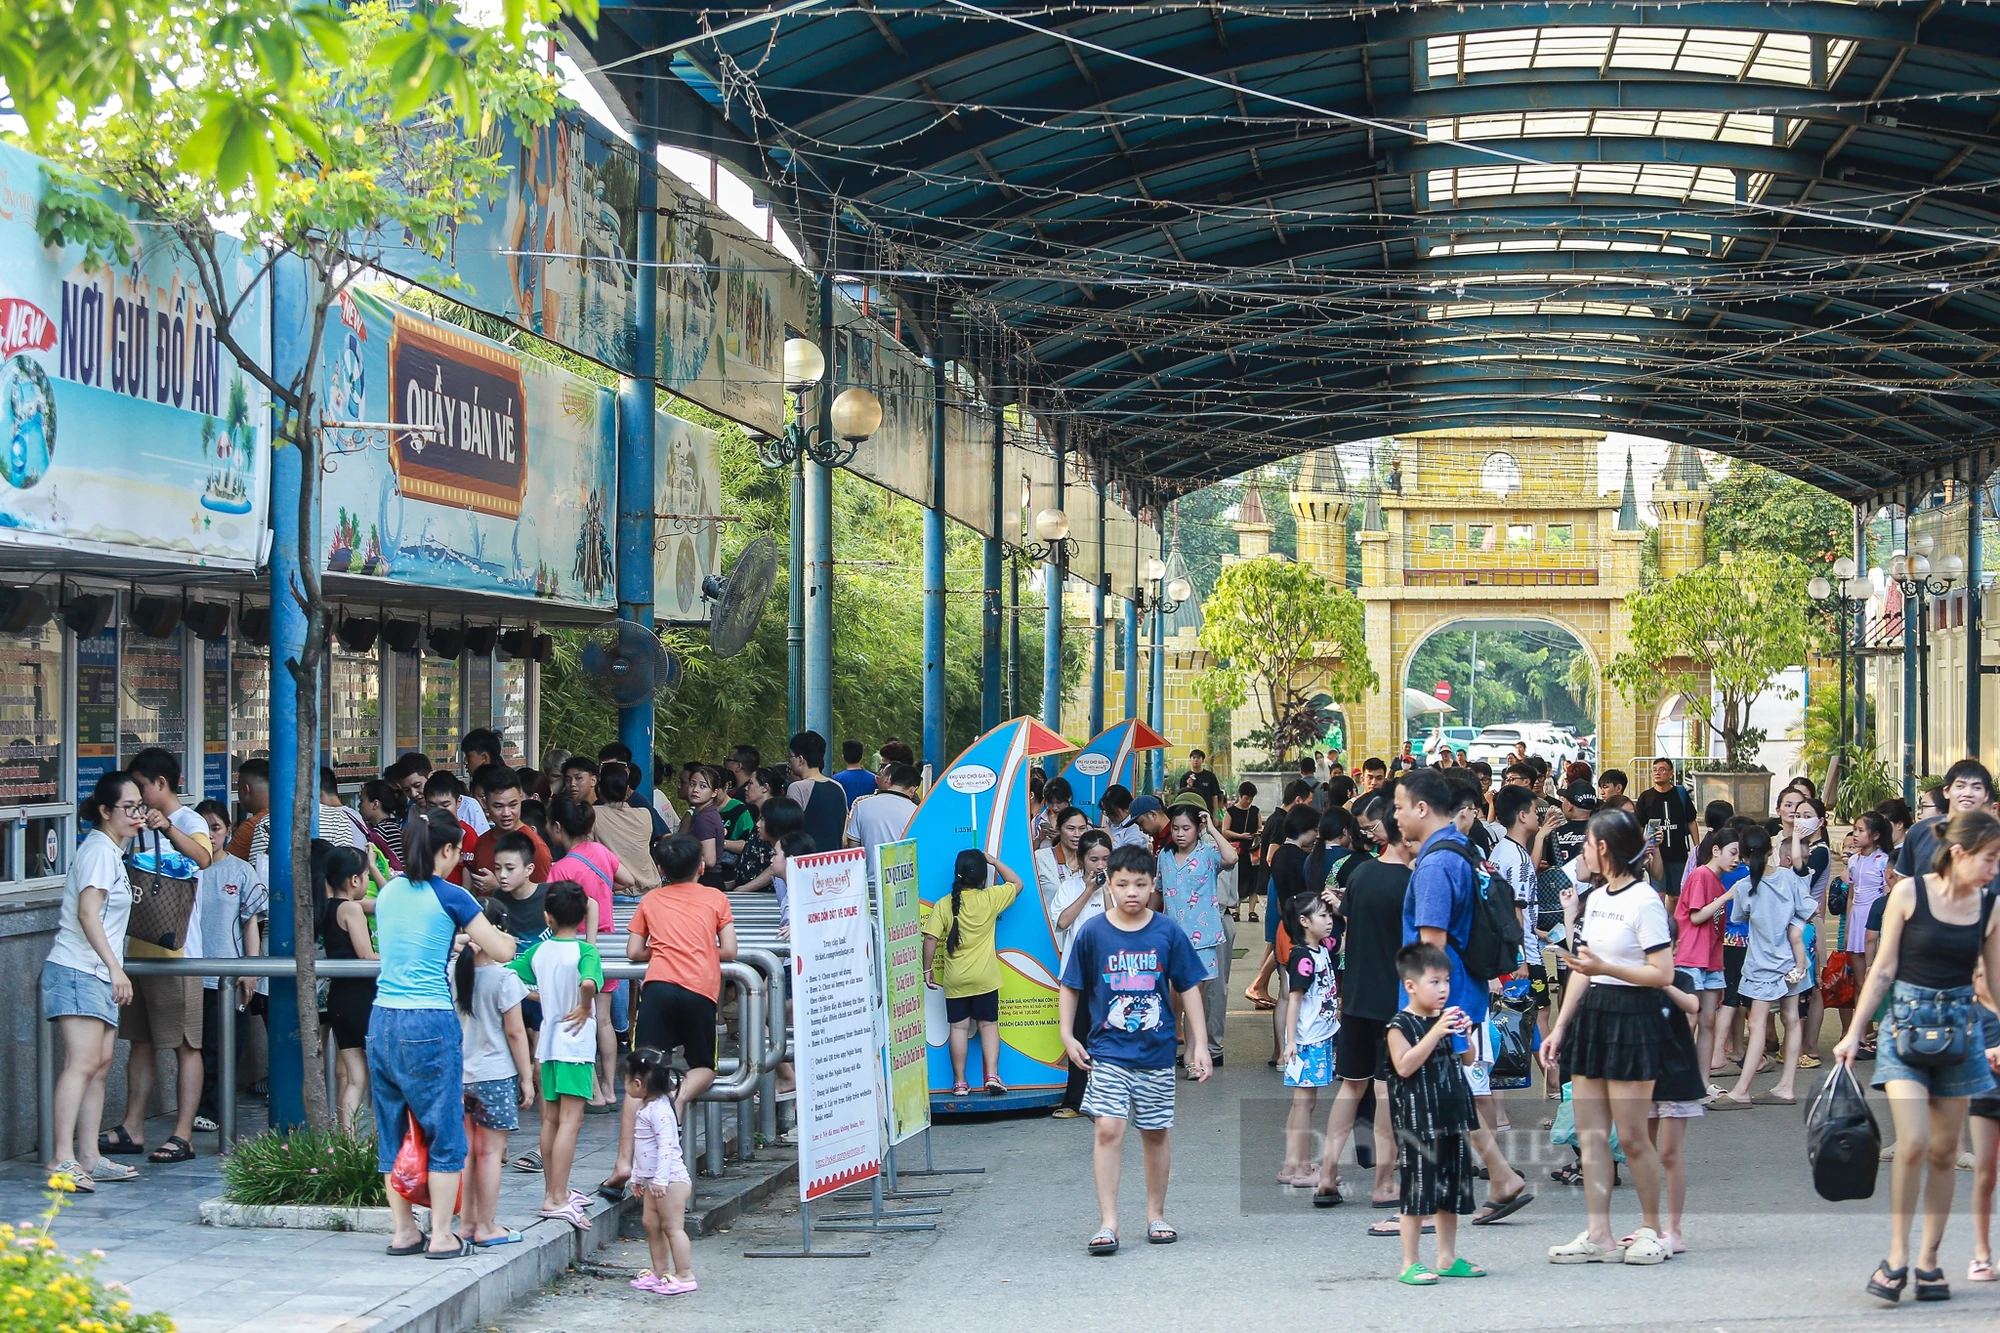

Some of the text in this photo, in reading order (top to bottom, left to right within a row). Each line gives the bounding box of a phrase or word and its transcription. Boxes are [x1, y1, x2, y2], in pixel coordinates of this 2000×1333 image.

[4, 309, 48, 348] NEW
[60, 261, 220, 416] NƠI GỬI ĐỒ ĂN
[342, 294, 364, 334] NEW
[406, 364, 457, 447] QUẦY
[460, 386, 493, 459] BÁN
[495, 398, 516, 464] VÉ
